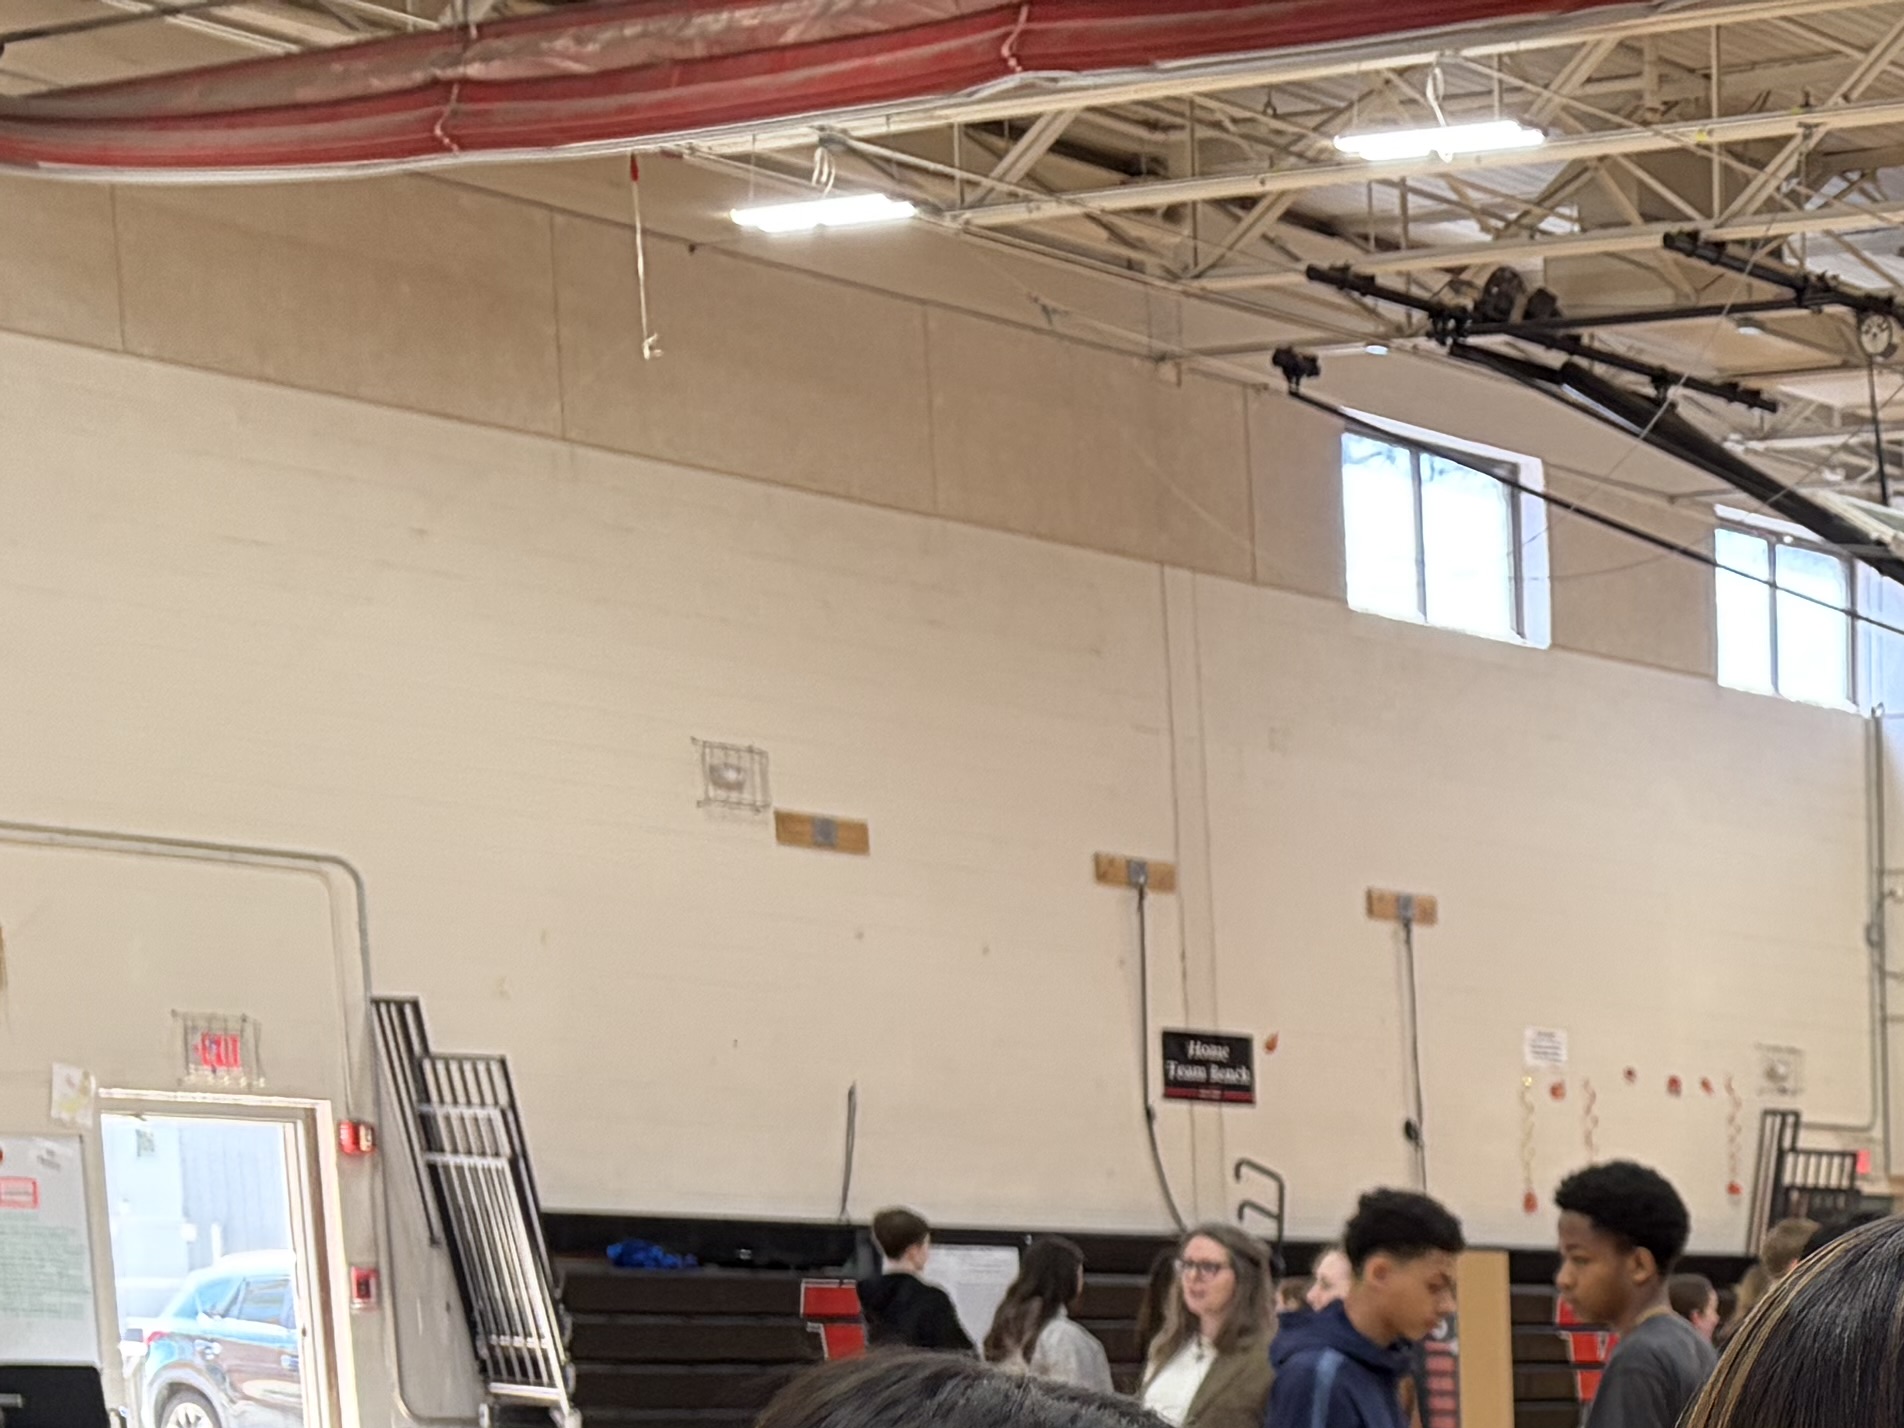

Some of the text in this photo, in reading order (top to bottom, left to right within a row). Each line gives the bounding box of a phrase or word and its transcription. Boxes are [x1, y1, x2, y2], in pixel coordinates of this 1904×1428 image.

[1187, 1040, 1230, 1062] Home
[1167, 1061, 1251, 1085] Team Bench
